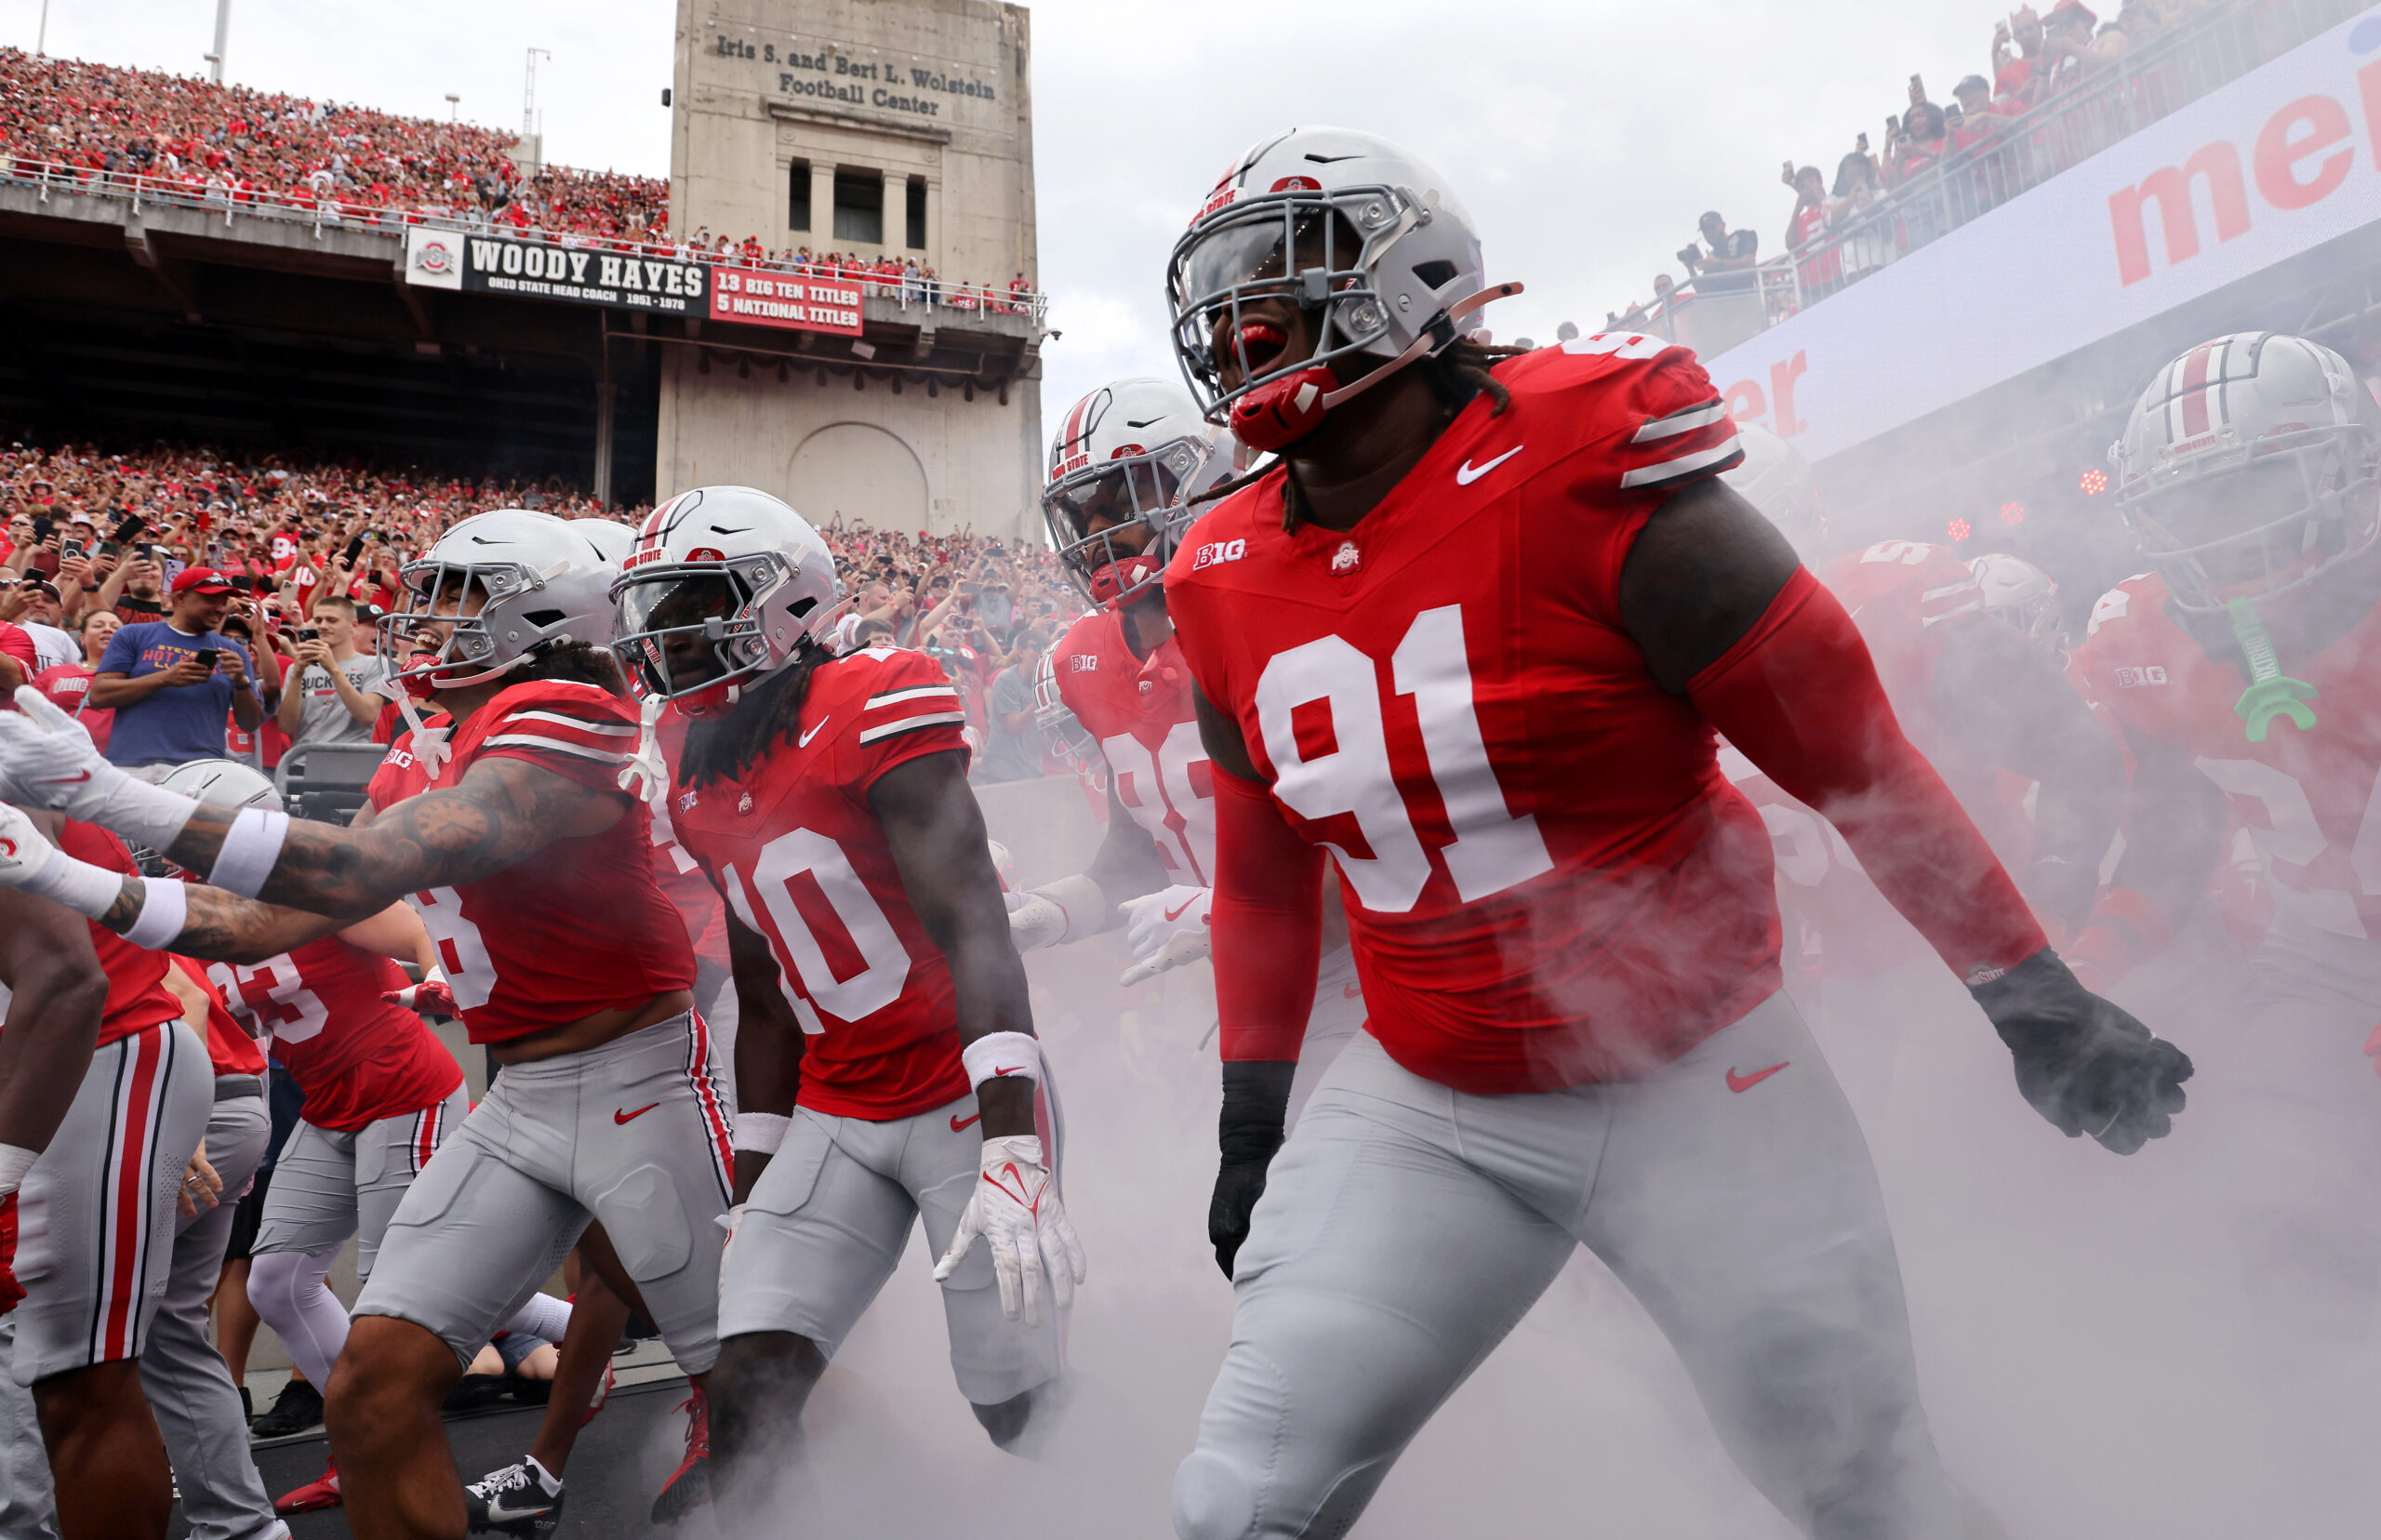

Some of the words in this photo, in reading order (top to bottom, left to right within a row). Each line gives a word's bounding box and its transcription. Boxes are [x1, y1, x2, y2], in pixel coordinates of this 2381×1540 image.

[717, 35, 755, 60] Iris
[765, 44, 780, 64] S.
[789, 52, 827, 72] and
[835, 56, 877, 80] Bert
[885, 63, 905, 85] L.
[911, 68, 995, 100] Wolstein
[779, 73, 864, 104] Football
[872, 87, 938, 115] Center
[471, 239, 590, 283] WOODY
[599, 256, 702, 298] HAYES
[488, 276, 516, 290] OHIO
[518, 281, 551, 294] STATE
[552, 284, 580, 298] HEAD
[582, 287, 618, 302] COACH
[627, 293, 651, 306] 1951
[659, 297, 685, 310] 1978
[718, 272, 740, 292] 13
[746, 278, 773, 297] BIG
[776, 282, 804, 299] TEN
[808, 285, 858, 306] TITLES
[717, 294, 729, 311] 5
[733, 298, 805, 321] NATIONAL
[808, 307, 858, 326] TITLES
[639, 549, 662, 564] STATE
[142, 649, 175, 663] HOT
[1255, 604, 1555, 913] 91
